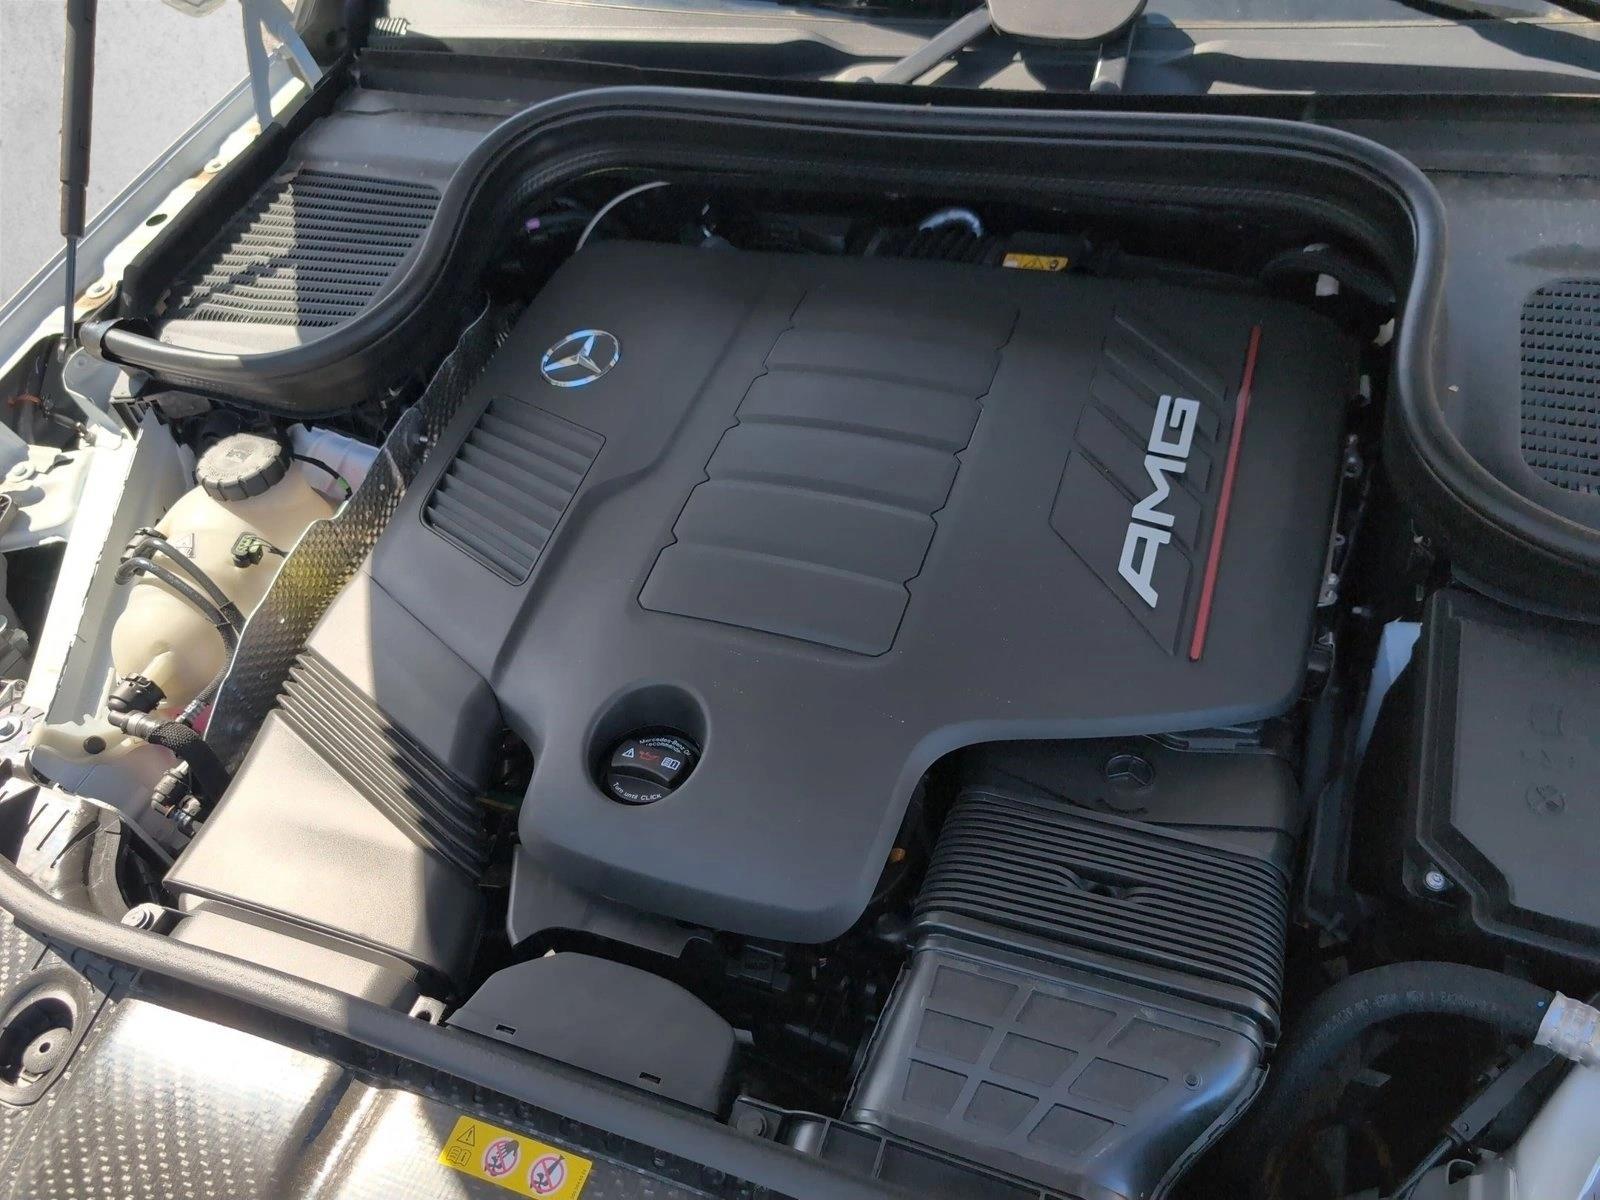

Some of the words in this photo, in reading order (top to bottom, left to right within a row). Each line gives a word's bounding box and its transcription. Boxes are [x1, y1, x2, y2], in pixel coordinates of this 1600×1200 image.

[1118, 395, 1200, 608] AMG
[639, 737, 685, 750] Mercedes-Benz
[613, 782, 624, 794] Turn
[623, 791, 639, 800] until
[640, 793, 662, 801] CLICK
